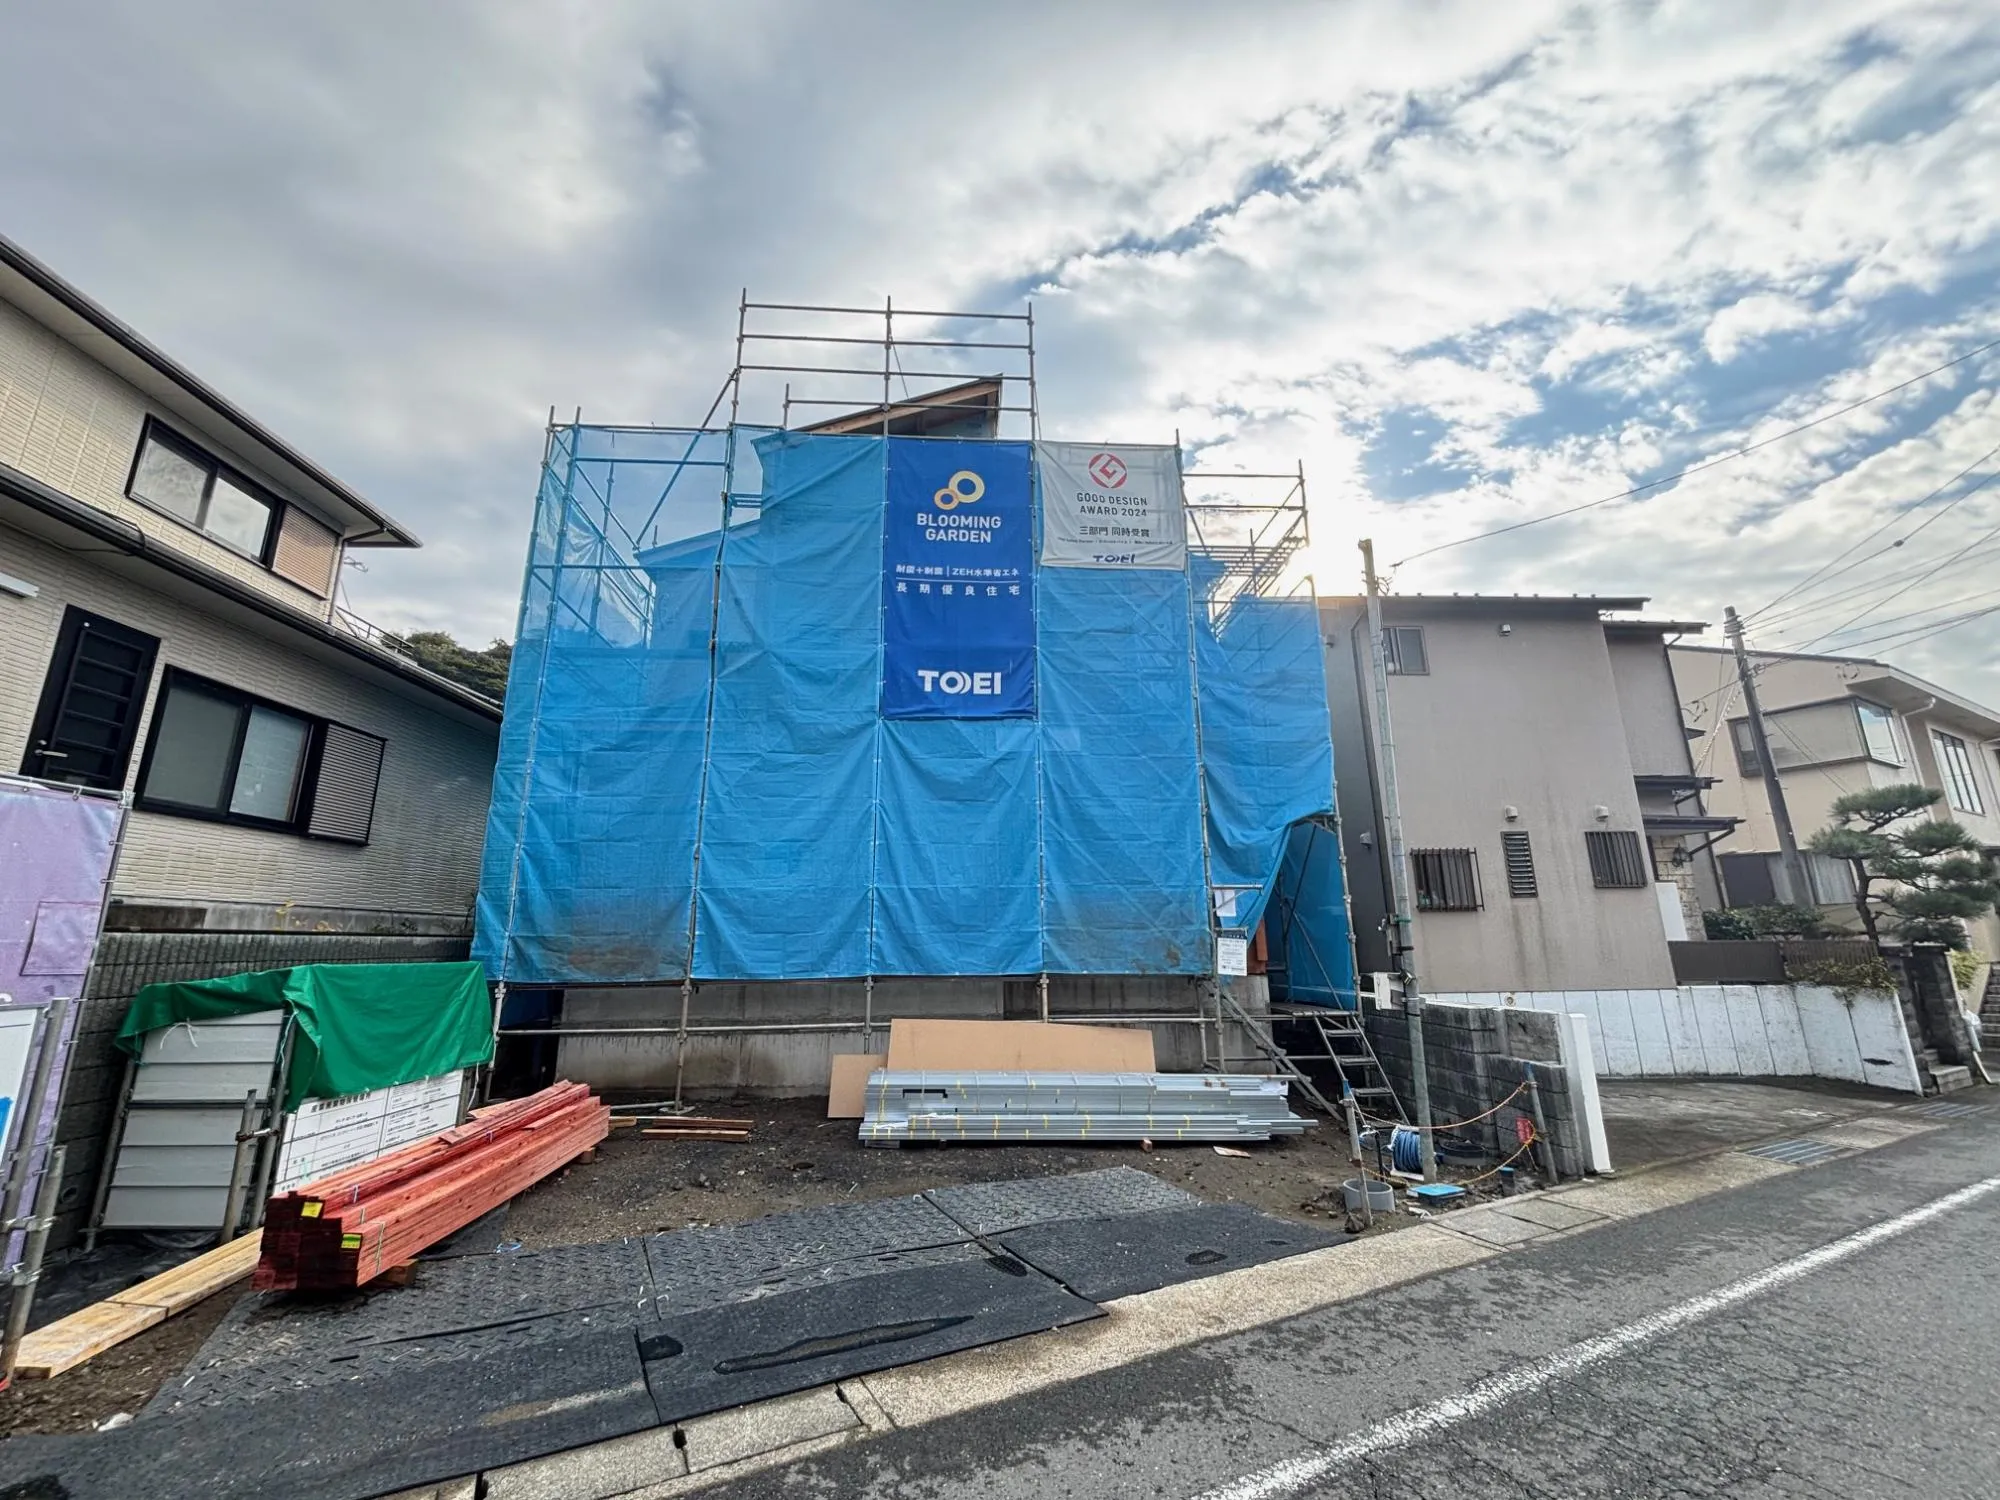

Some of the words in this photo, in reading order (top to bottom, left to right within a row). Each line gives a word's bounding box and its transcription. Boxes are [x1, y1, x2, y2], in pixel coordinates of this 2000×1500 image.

[1076, 492, 1106, 503] GOOD
[1108, 496, 1148, 506] DESIGN
[1080, 505, 1118, 515] AWARD
[1121, 508, 1147, 517] 2024
[916, 512, 1002, 529] BLOOMING
[925, 528, 992, 543] GARDEN
[1079, 526, 1109, 537] 三部門
